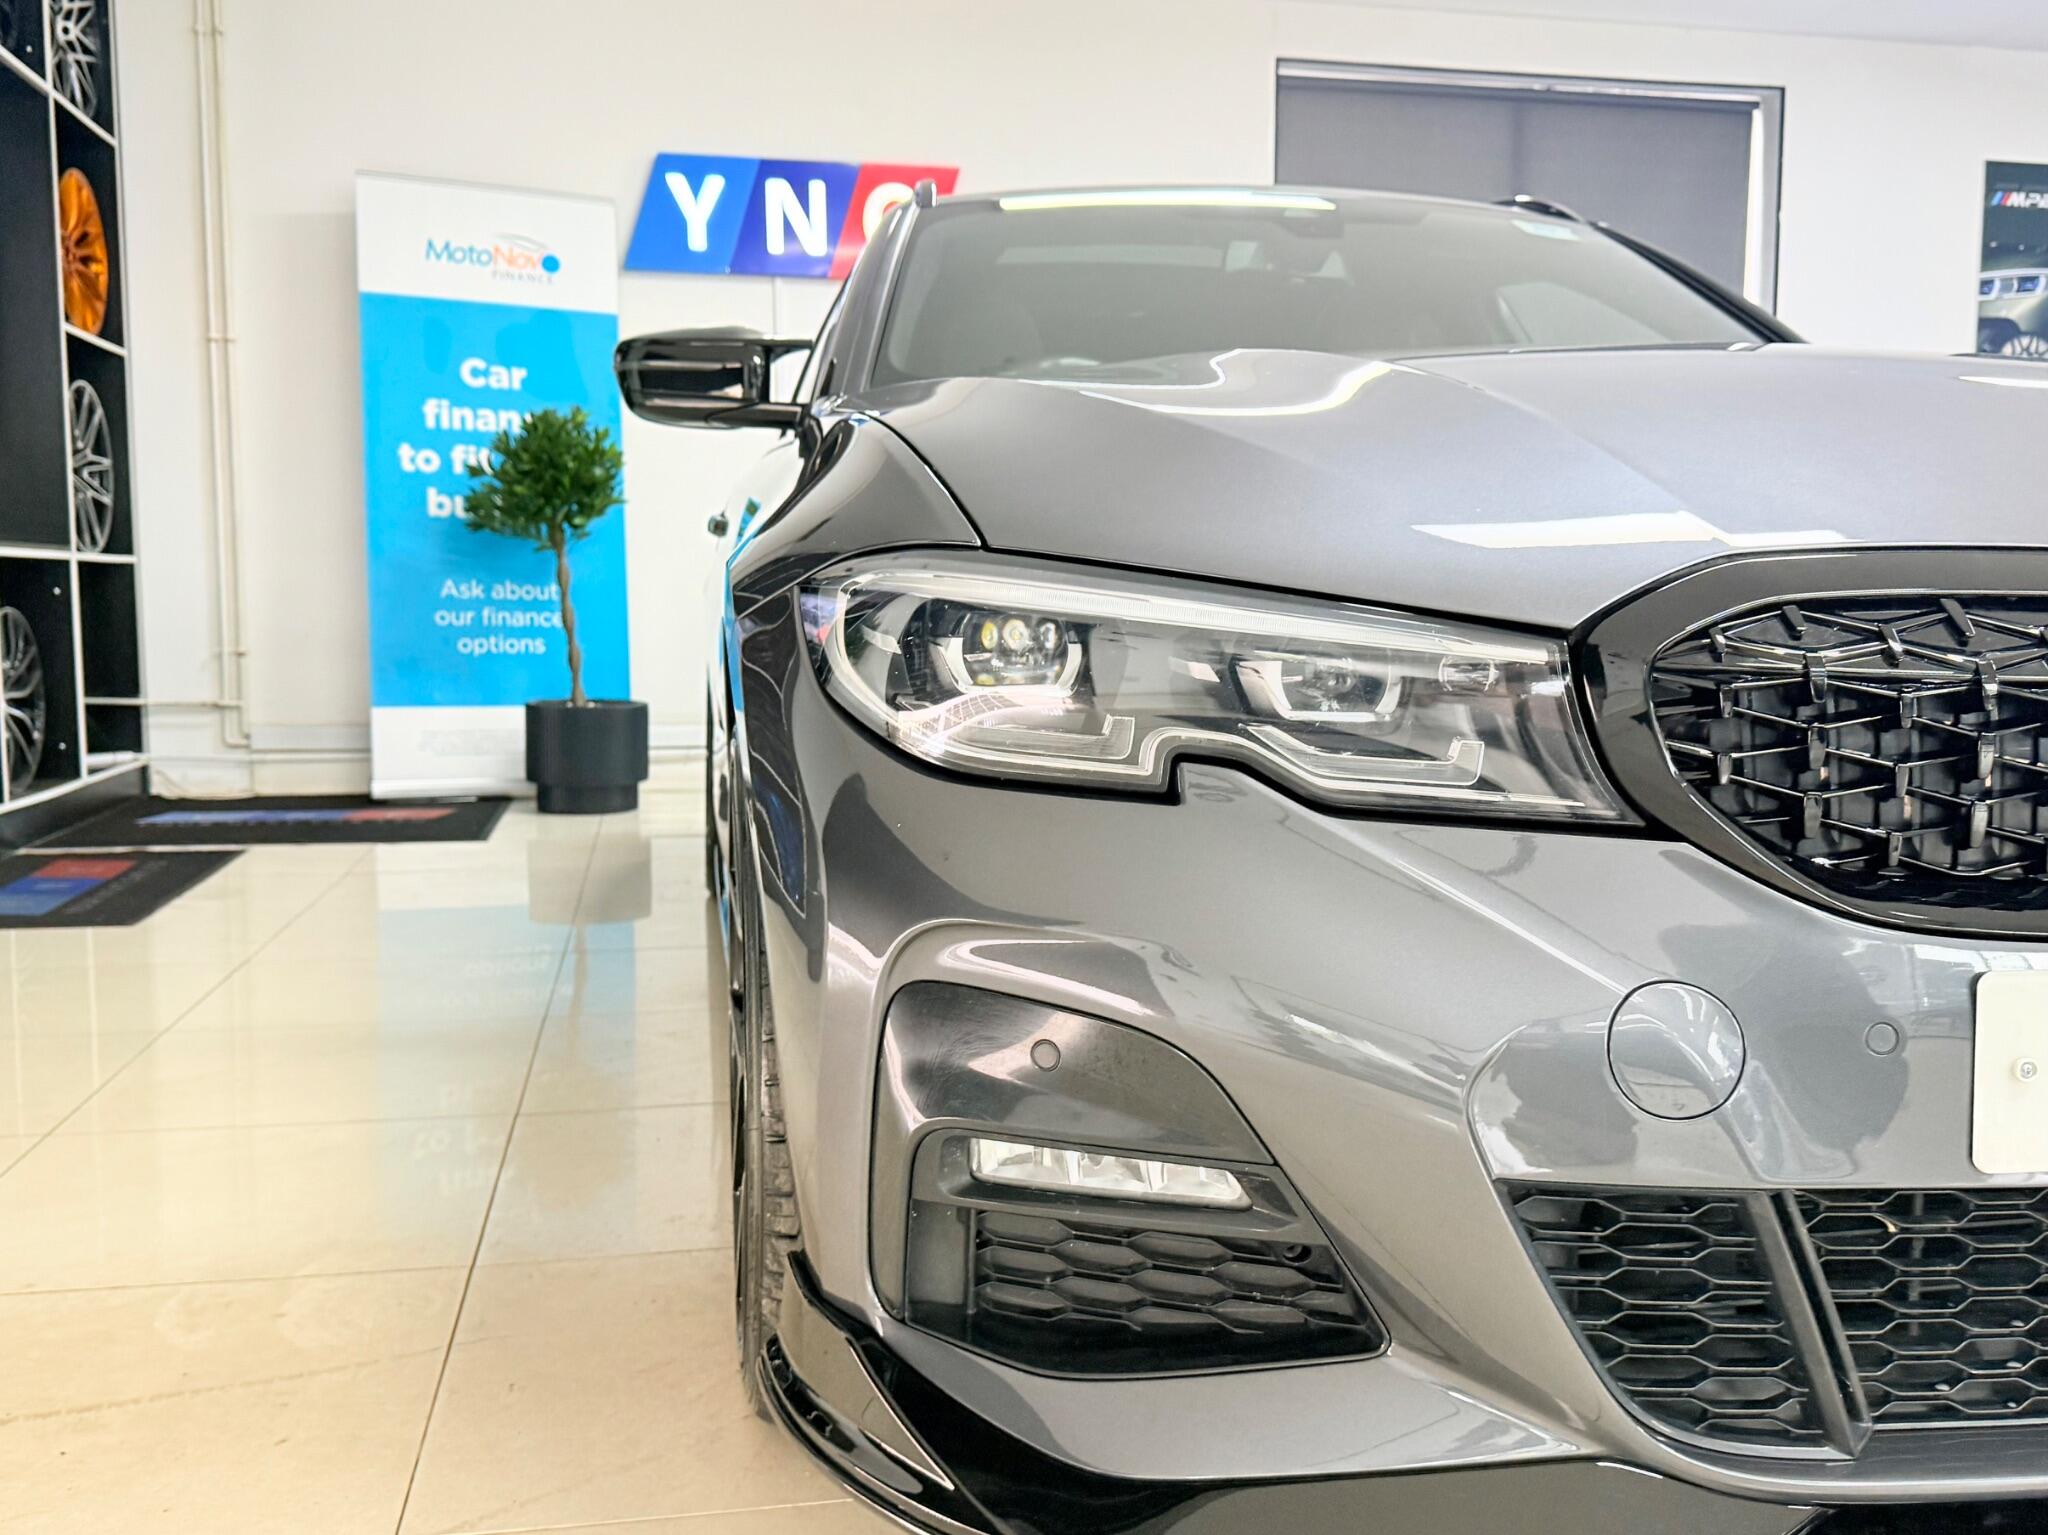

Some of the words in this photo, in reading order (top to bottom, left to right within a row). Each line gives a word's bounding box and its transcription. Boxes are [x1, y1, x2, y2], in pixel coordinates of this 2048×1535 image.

[459, 357, 528, 390] Car
[422, 397, 533, 434] finan
[398, 442, 441, 473] to
[440, 578, 485, 600] Ask
[491, 579, 560, 601] about
[434, 609, 476, 627] our
[457, 633, 547, 657] options
